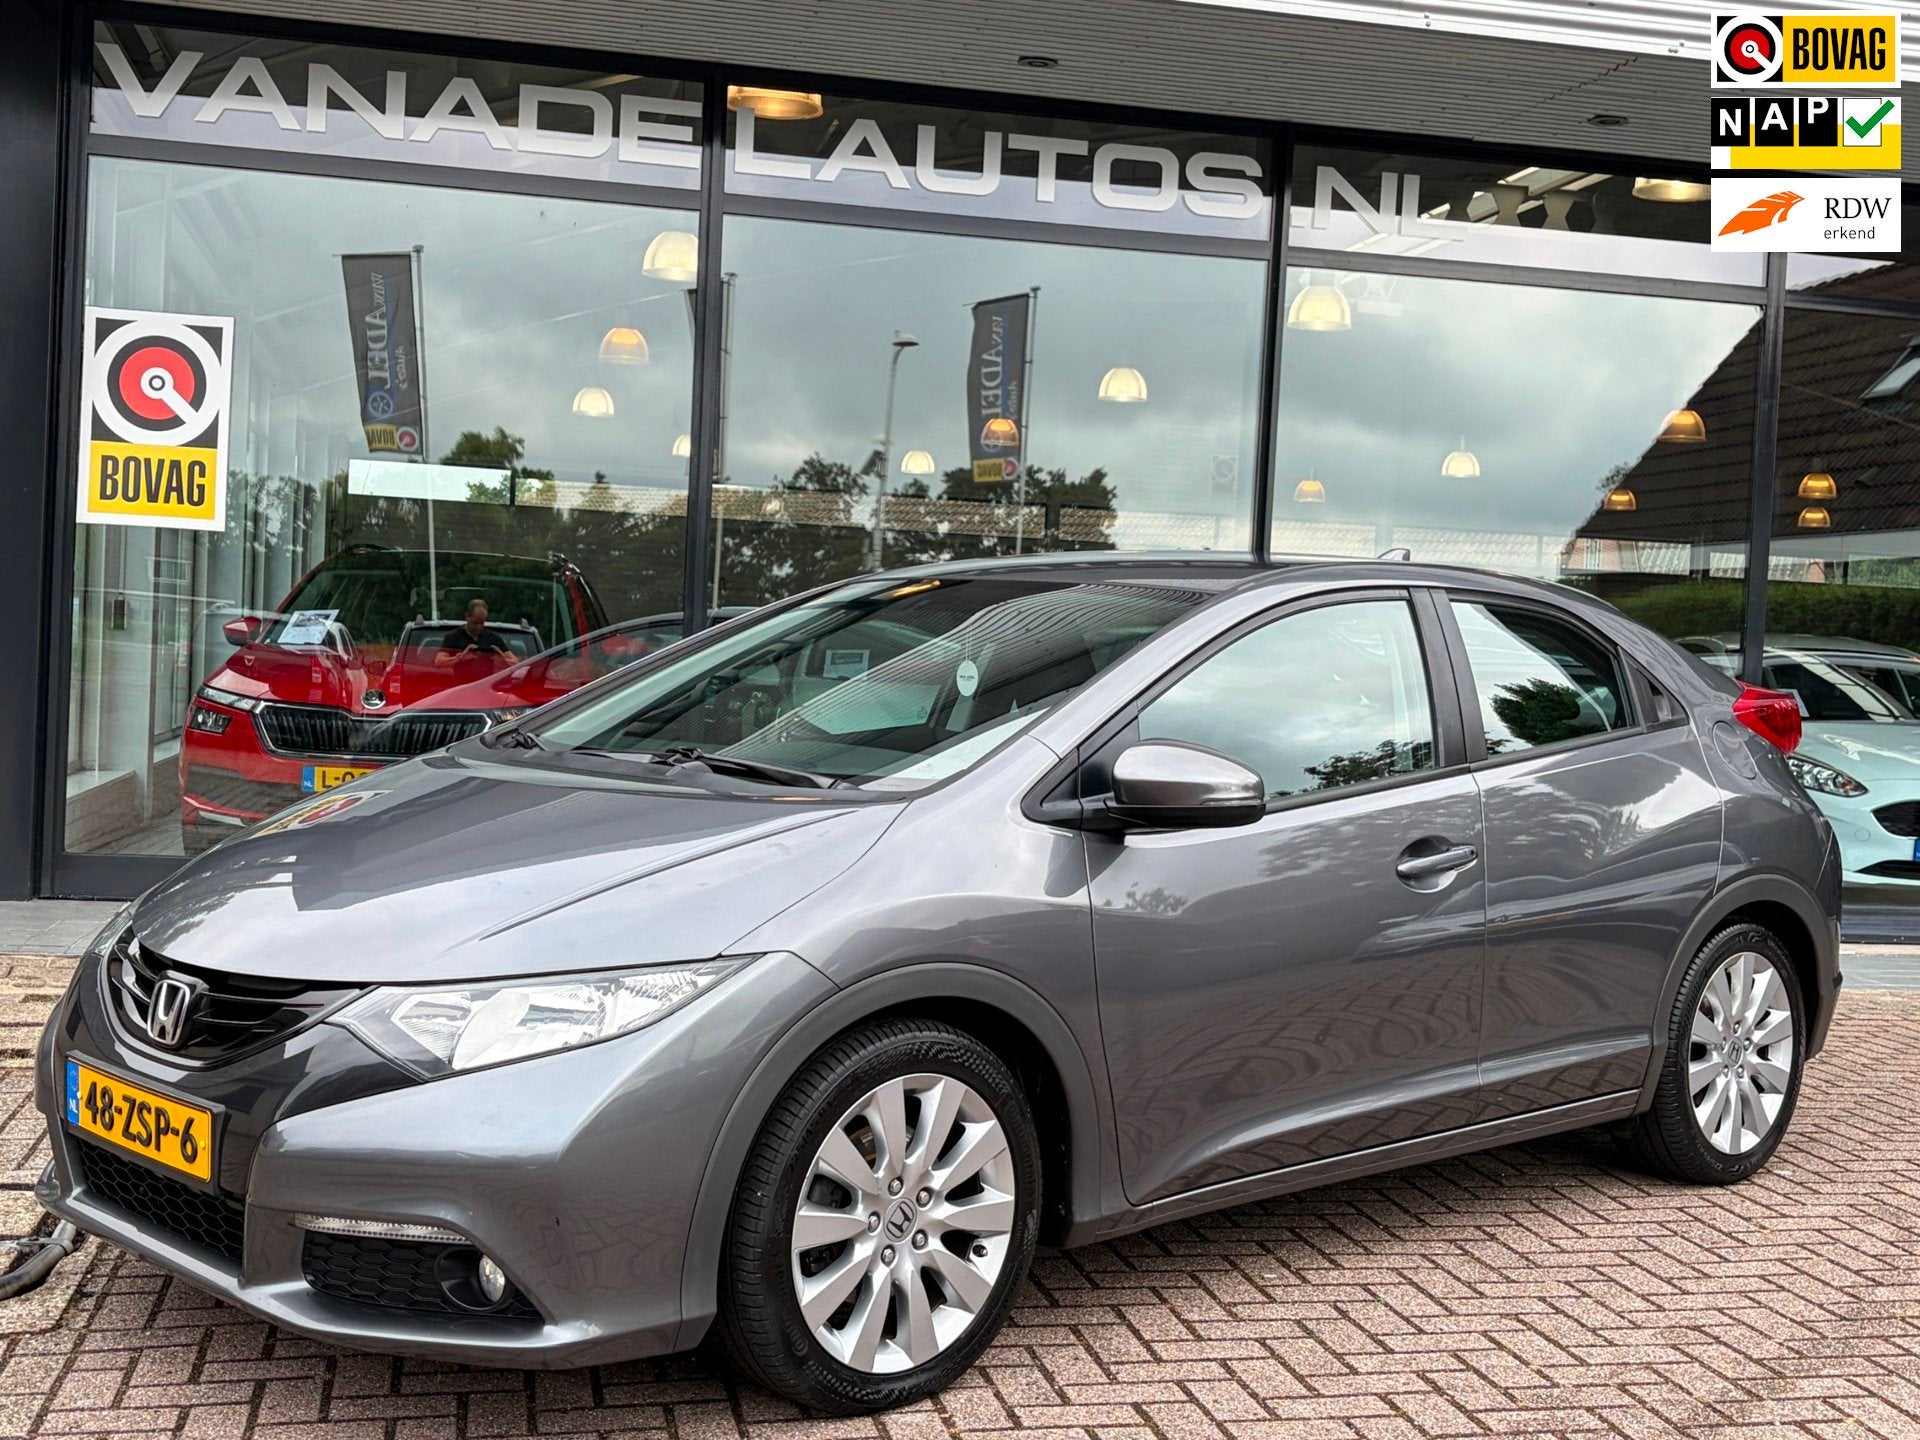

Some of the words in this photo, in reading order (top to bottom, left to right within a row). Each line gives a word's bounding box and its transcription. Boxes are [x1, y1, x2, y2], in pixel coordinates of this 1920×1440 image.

[99, 454, 207, 507] BOVAG
[69, 1099, 79, 1114] NL
[85, 1080, 199, 1165] 48-ZSP-6
